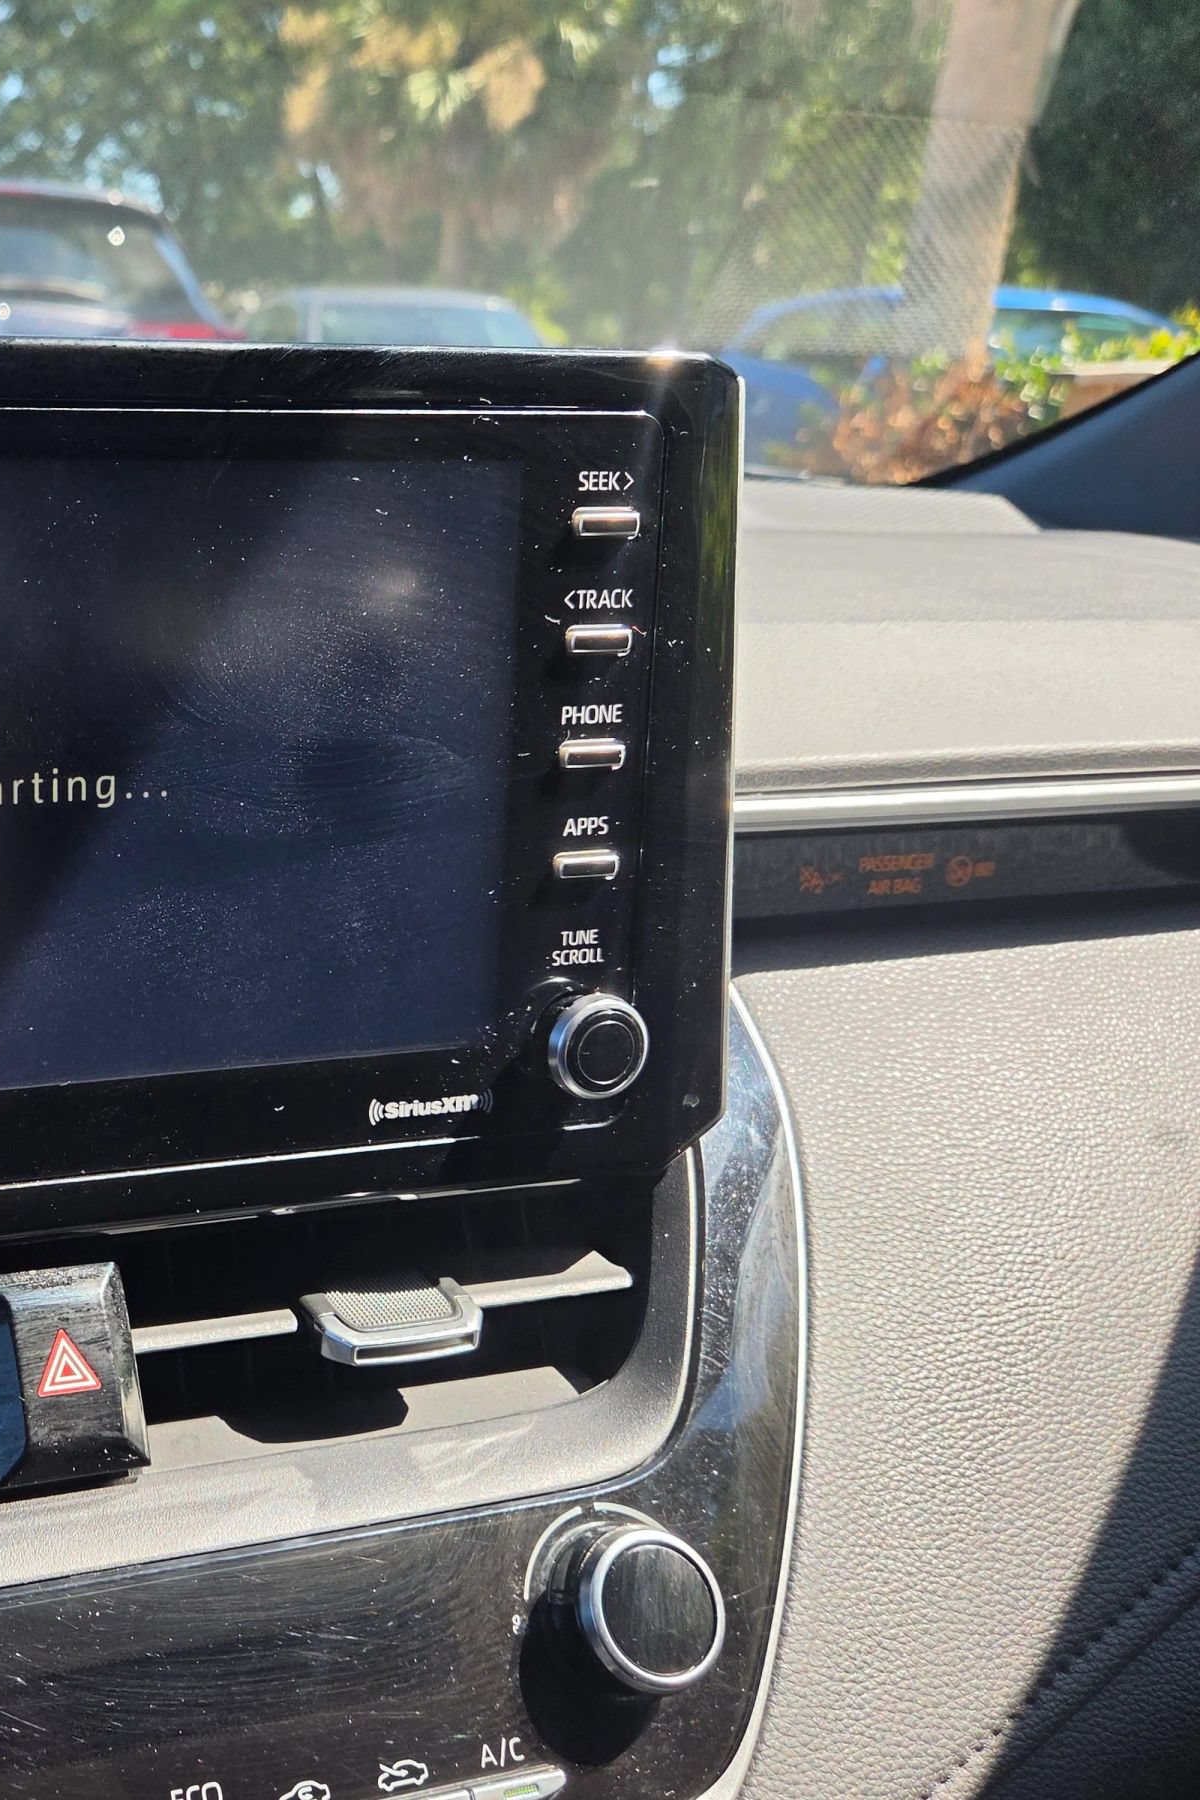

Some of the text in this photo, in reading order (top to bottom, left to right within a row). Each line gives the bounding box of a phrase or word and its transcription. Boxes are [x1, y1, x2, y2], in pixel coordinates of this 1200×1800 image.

[561, 704, 623, 725] PHONE
[562, 816, 609, 836] APPS
[560, 929, 599, 946] TUNE
[551, 948, 604, 966] SCROLL
[481, 1737, 525, 1769] A/C
